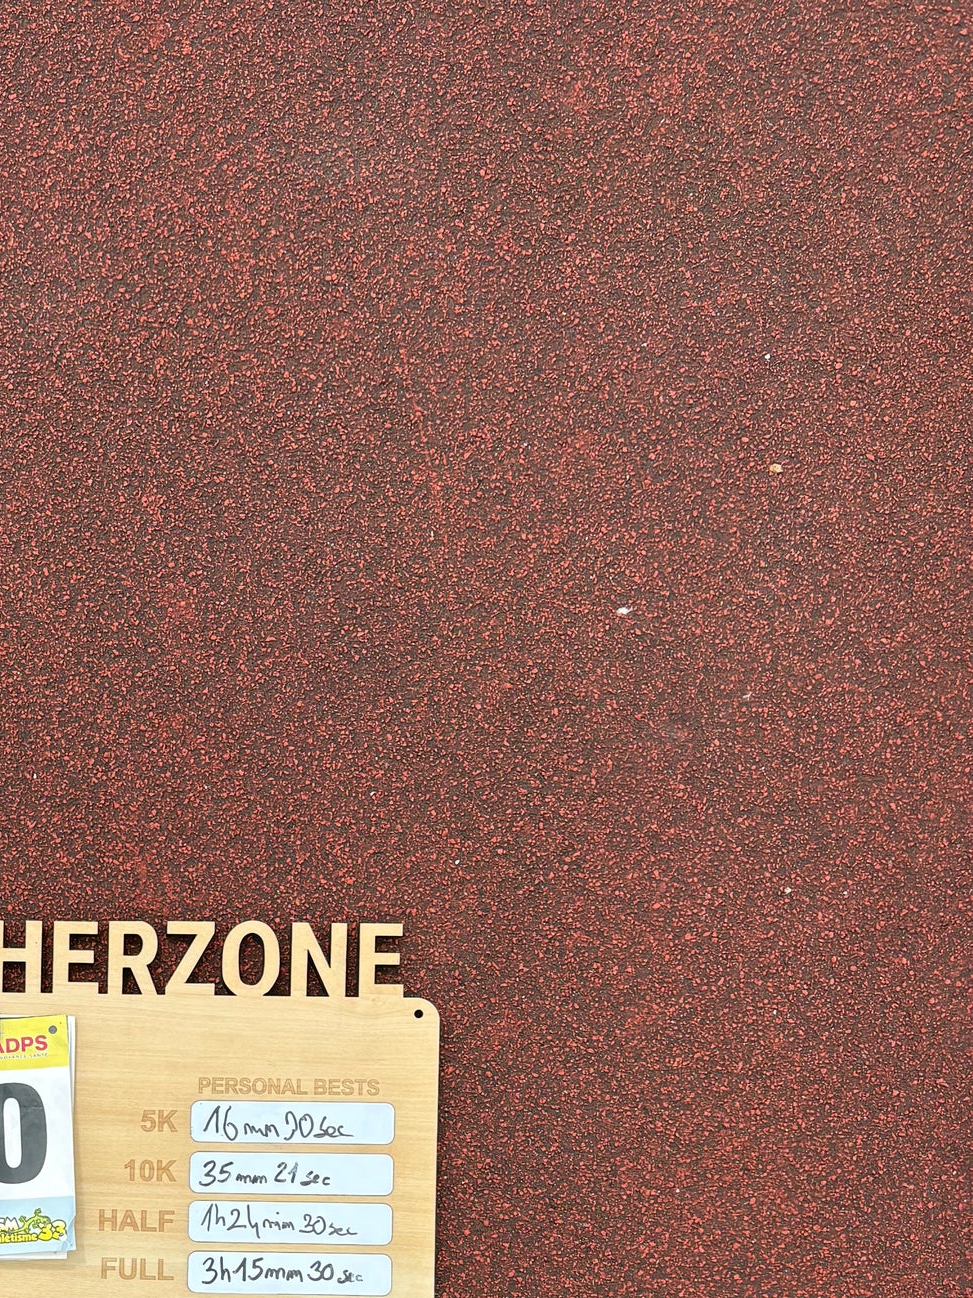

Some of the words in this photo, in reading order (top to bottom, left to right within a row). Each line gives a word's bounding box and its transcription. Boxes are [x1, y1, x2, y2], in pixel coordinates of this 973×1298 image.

[198, 1077, 308, 1095] PERSONAL
[314, 1079, 380, 1096] BESTS
[140, 1110, 178, 1132] 5K
[124, 1159, 177, 1182] 10K
[98, 1209, 175, 1232] HALF
[100, 1257, 174, 1280] FULL
